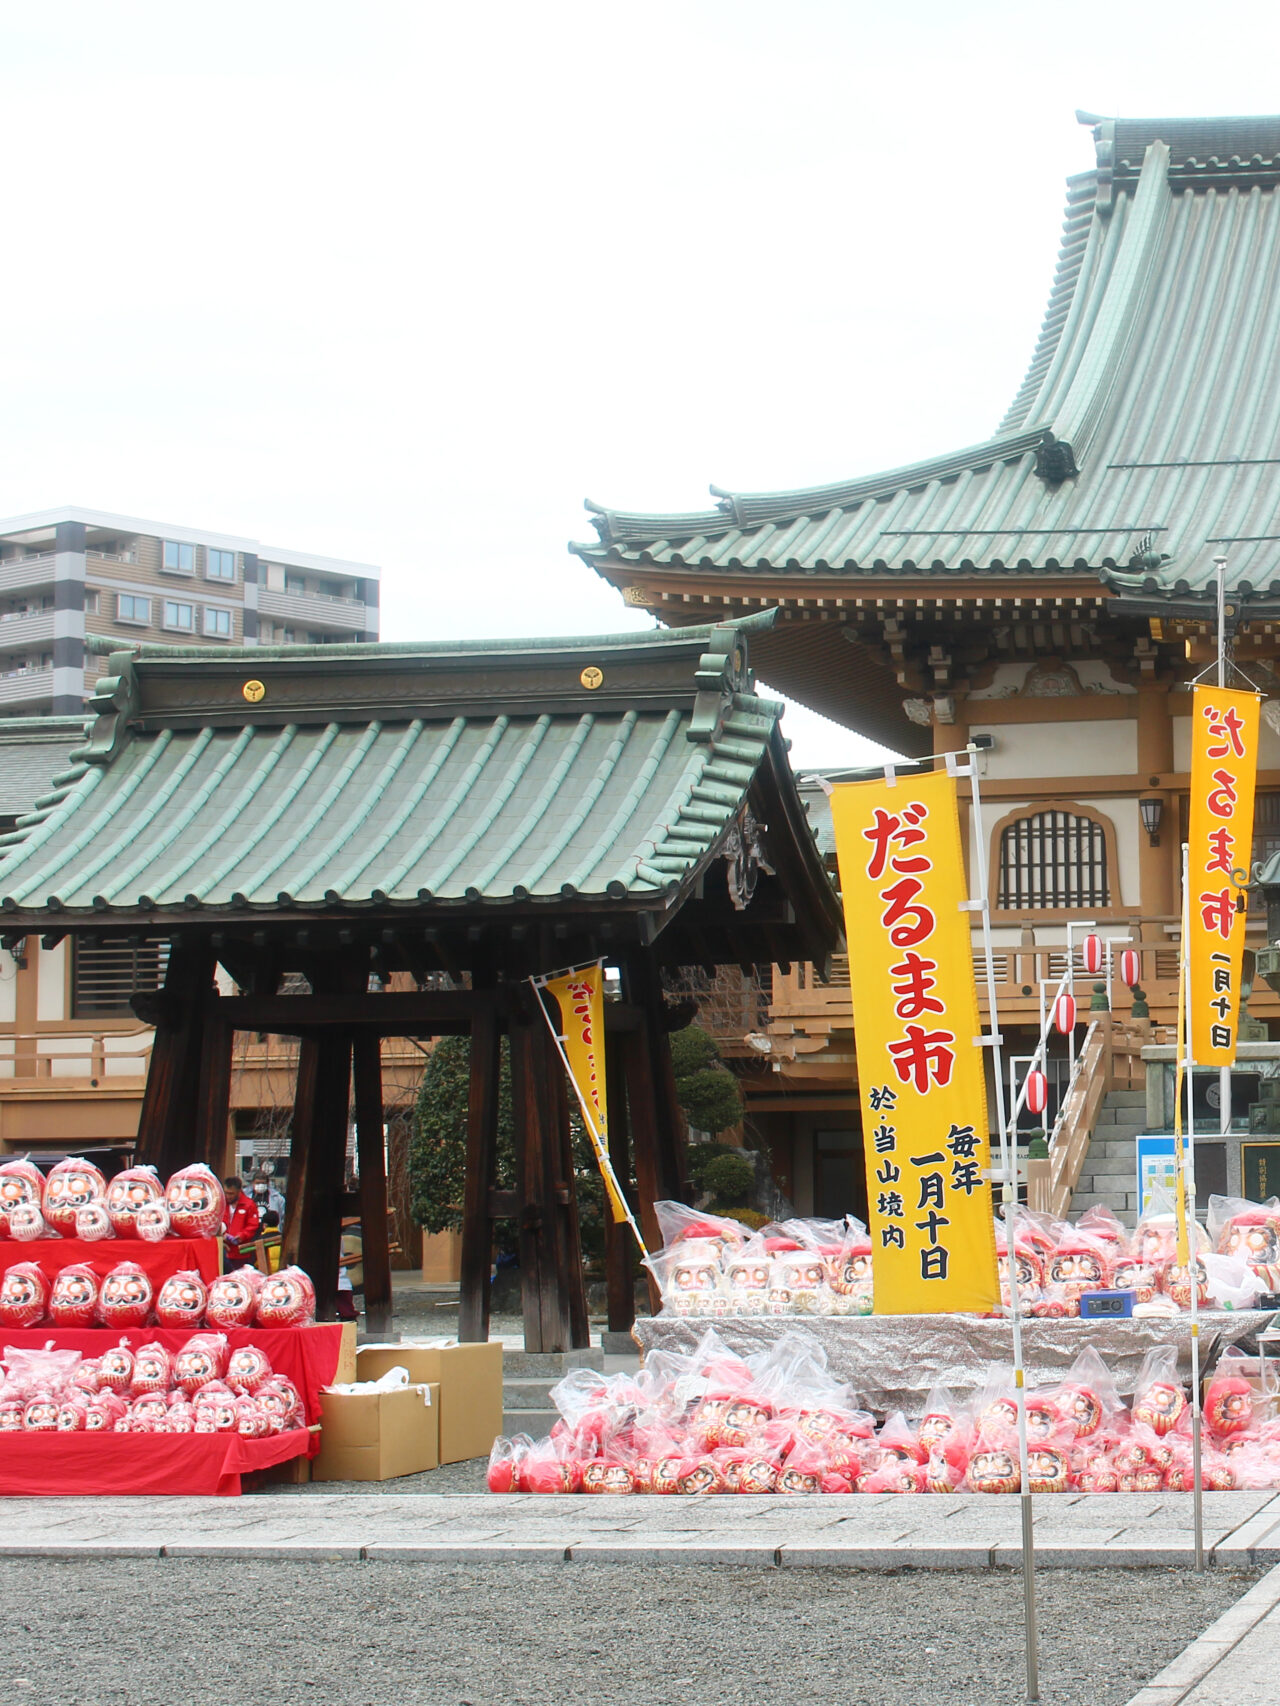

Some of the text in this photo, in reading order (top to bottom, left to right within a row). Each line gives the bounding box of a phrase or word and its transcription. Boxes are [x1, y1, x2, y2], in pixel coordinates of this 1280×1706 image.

[864, 803, 955, 1093] だるま市
[869, 1087, 905, 1248] 於・当山境内
[910, 1153, 948, 1279] 一月十日
[947, 1126, 983, 1194] 毎年
